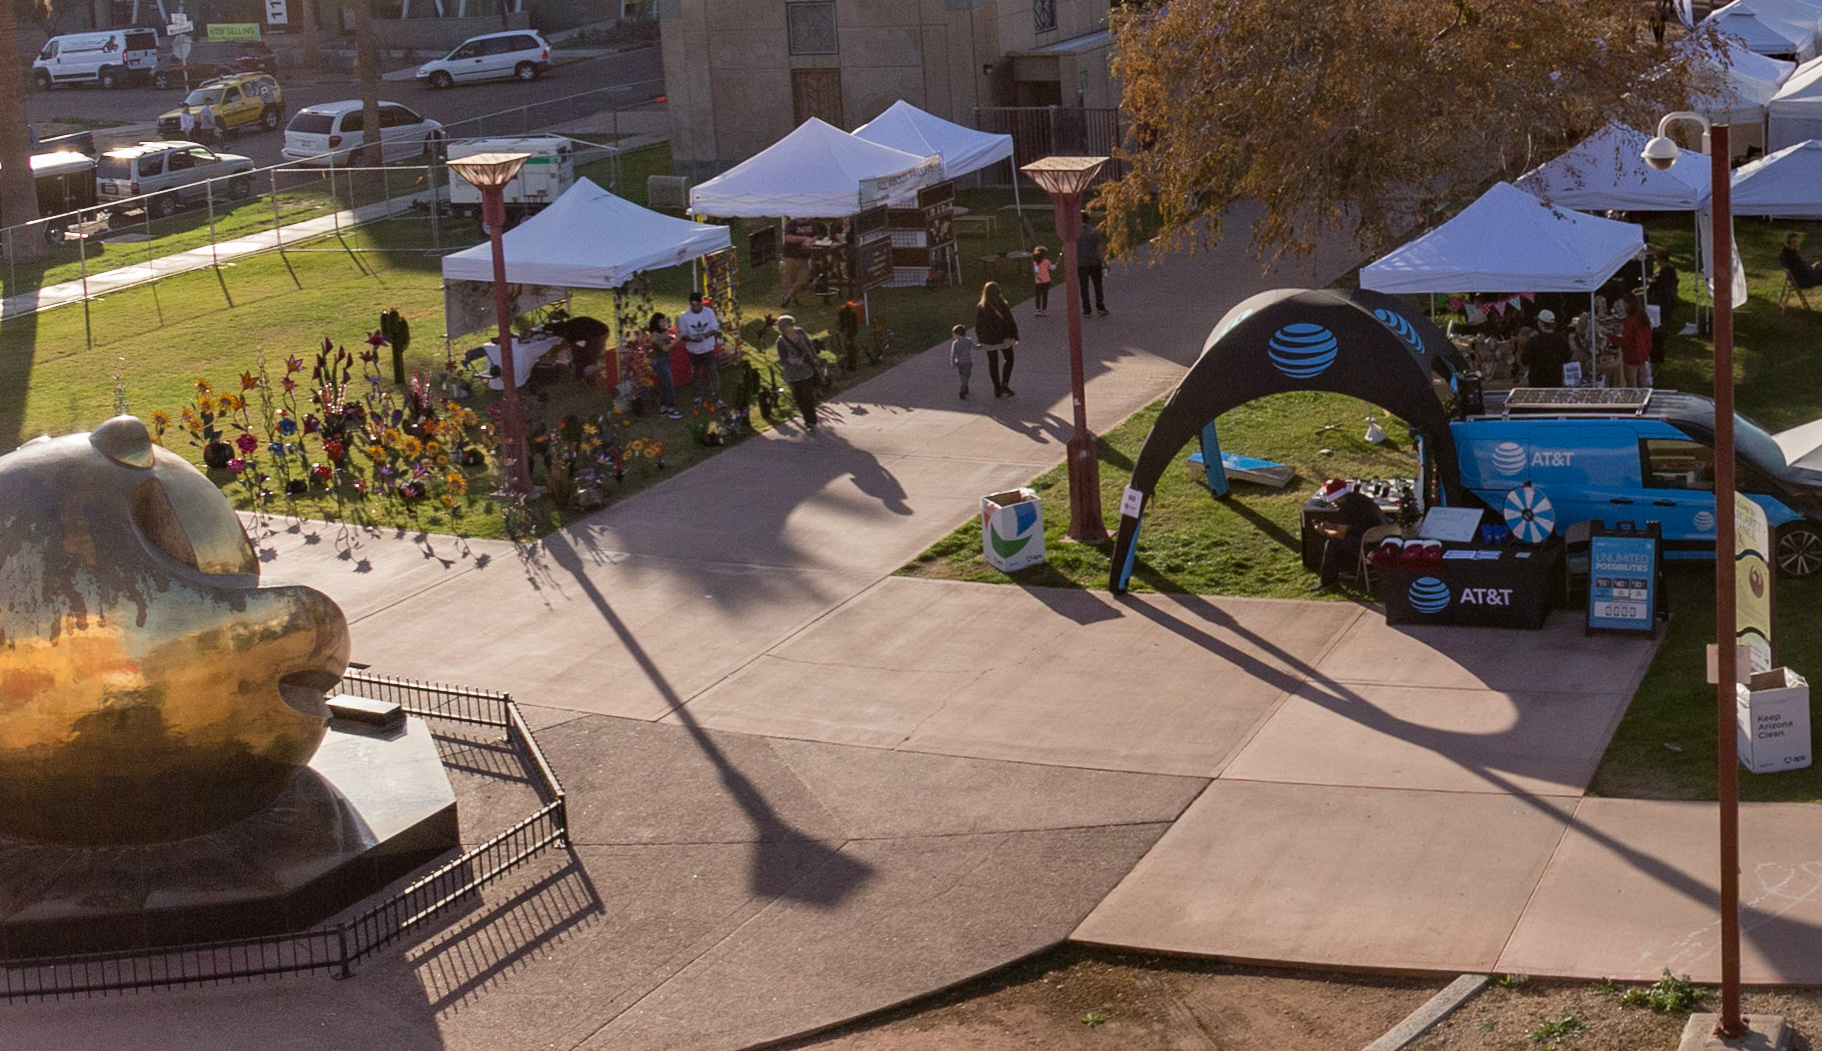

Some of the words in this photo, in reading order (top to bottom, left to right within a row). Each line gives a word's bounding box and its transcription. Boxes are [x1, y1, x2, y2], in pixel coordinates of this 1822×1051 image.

[227, 26, 255, 35] SELLING
[1531, 452, 1574, 466] AT&T
[1595, 553, 1649, 564] UNLIMITED
[1595, 562, 1649, 572] POSSIBILITIES
[1460, 588, 1513, 605] AT&T
[1757, 714, 1781, 722] Keep
[1758, 721, 1793, 730] Arizona
